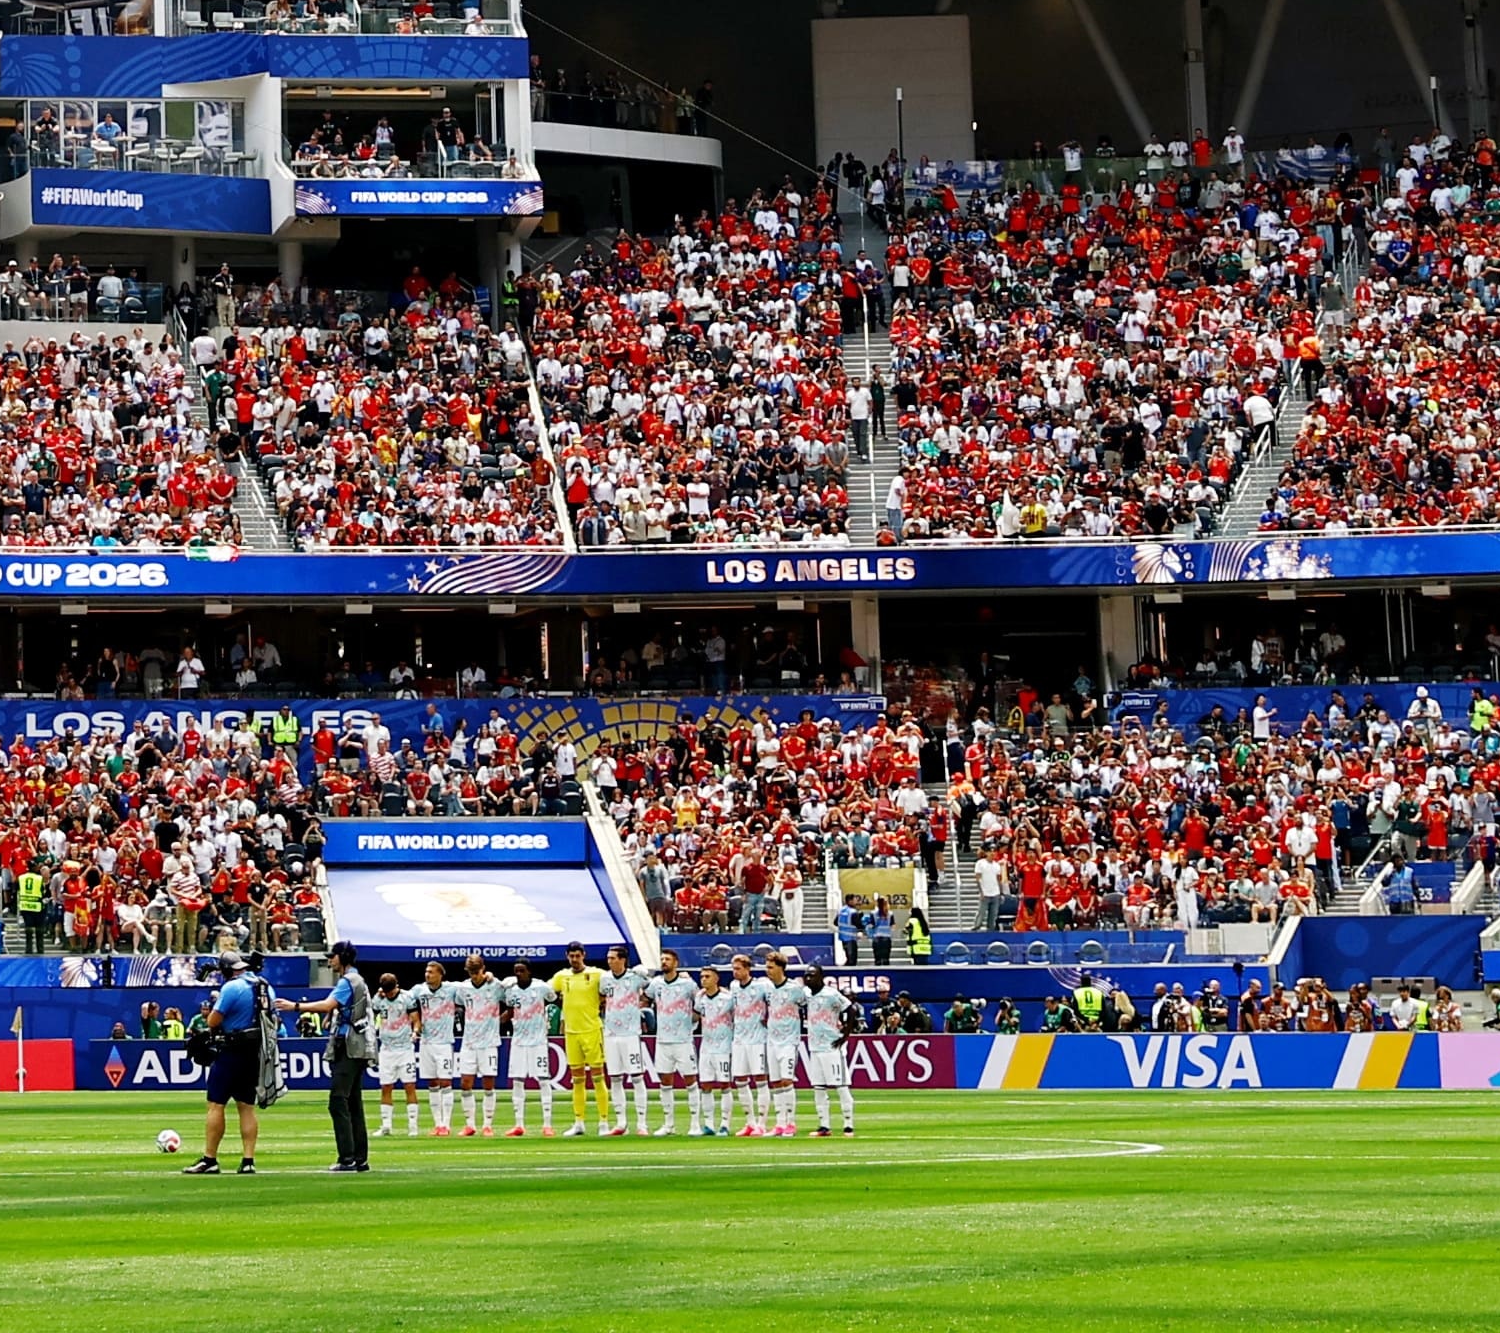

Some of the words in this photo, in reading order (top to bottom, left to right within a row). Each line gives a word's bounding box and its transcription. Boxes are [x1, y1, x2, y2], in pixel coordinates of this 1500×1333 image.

[42, 188, 143, 210] #FIFAWorldCup
[351, 191, 377, 203] FIFA
[378, 191, 420, 203] WORLD
[421, 191, 445, 203] CUP
[446, 191, 488, 203] 2026
[6, 563, 62, 586] CUP
[66, 563, 168, 586] 2026
[707, 560, 765, 583] LOS
[775, 558, 915, 581] ANGELES
[26, 712, 125, 738] LOS
[359, 836, 393, 849] FIFA
[395, 836, 454, 849] WORLD
[456, 835, 489, 849] CUP
[491, 835, 549, 849] 2026
[414, 948, 439, 958] FIFA
[483, 947, 506, 957] CUP
[507, 946, 547, 957] 2026
[488, 1056, 497, 1067] 17
[536, 1057, 547, 1068] 25
[719, 1061, 729, 1072] 10
[1106, 1035, 1262, 1088] VISA
[832, 1064, 840, 1075] 11
